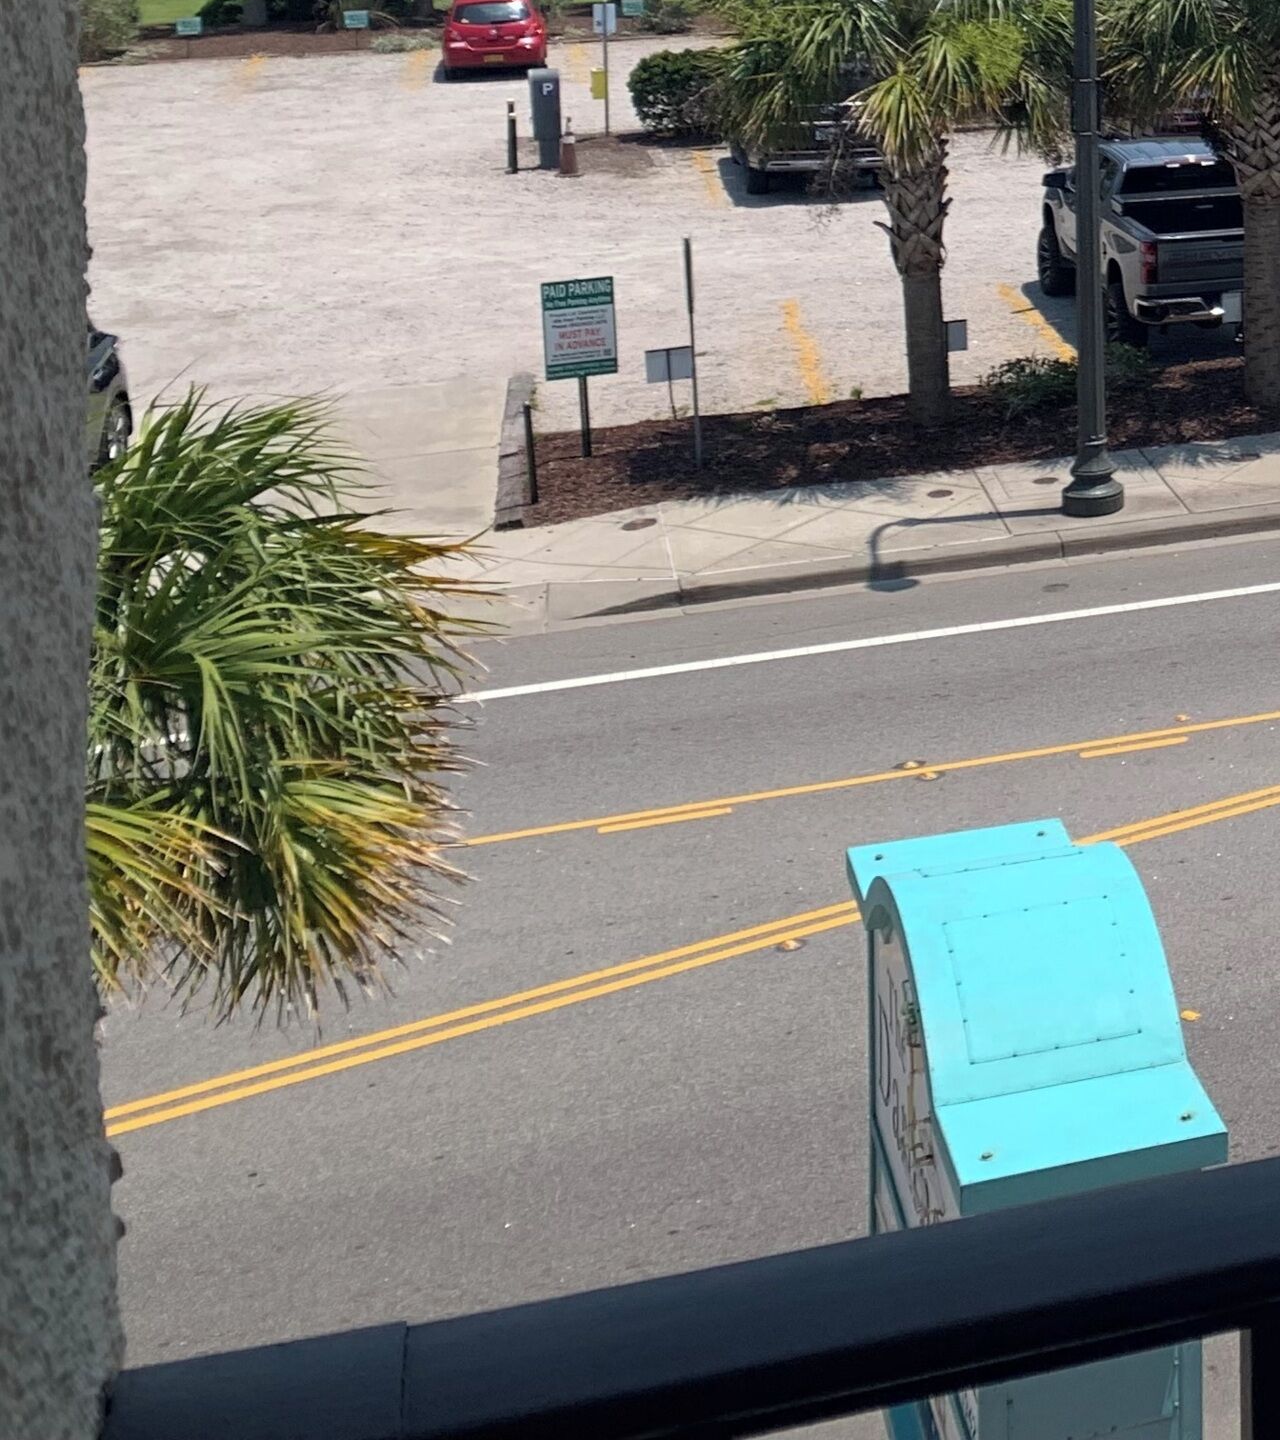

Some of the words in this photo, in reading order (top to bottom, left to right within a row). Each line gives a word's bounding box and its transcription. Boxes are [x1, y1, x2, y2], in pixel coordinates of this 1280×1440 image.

[542, 83, 553, 96] P
[543, 284, 566, 299] PAID
[568, 279, 611, 297] PARKING
[559, 330, 581, 340] MUST
[585, 328, 600, 337] PAY
[554, 342, 564, 351] IN
[567, 338, 606, 349] ADVANCE
